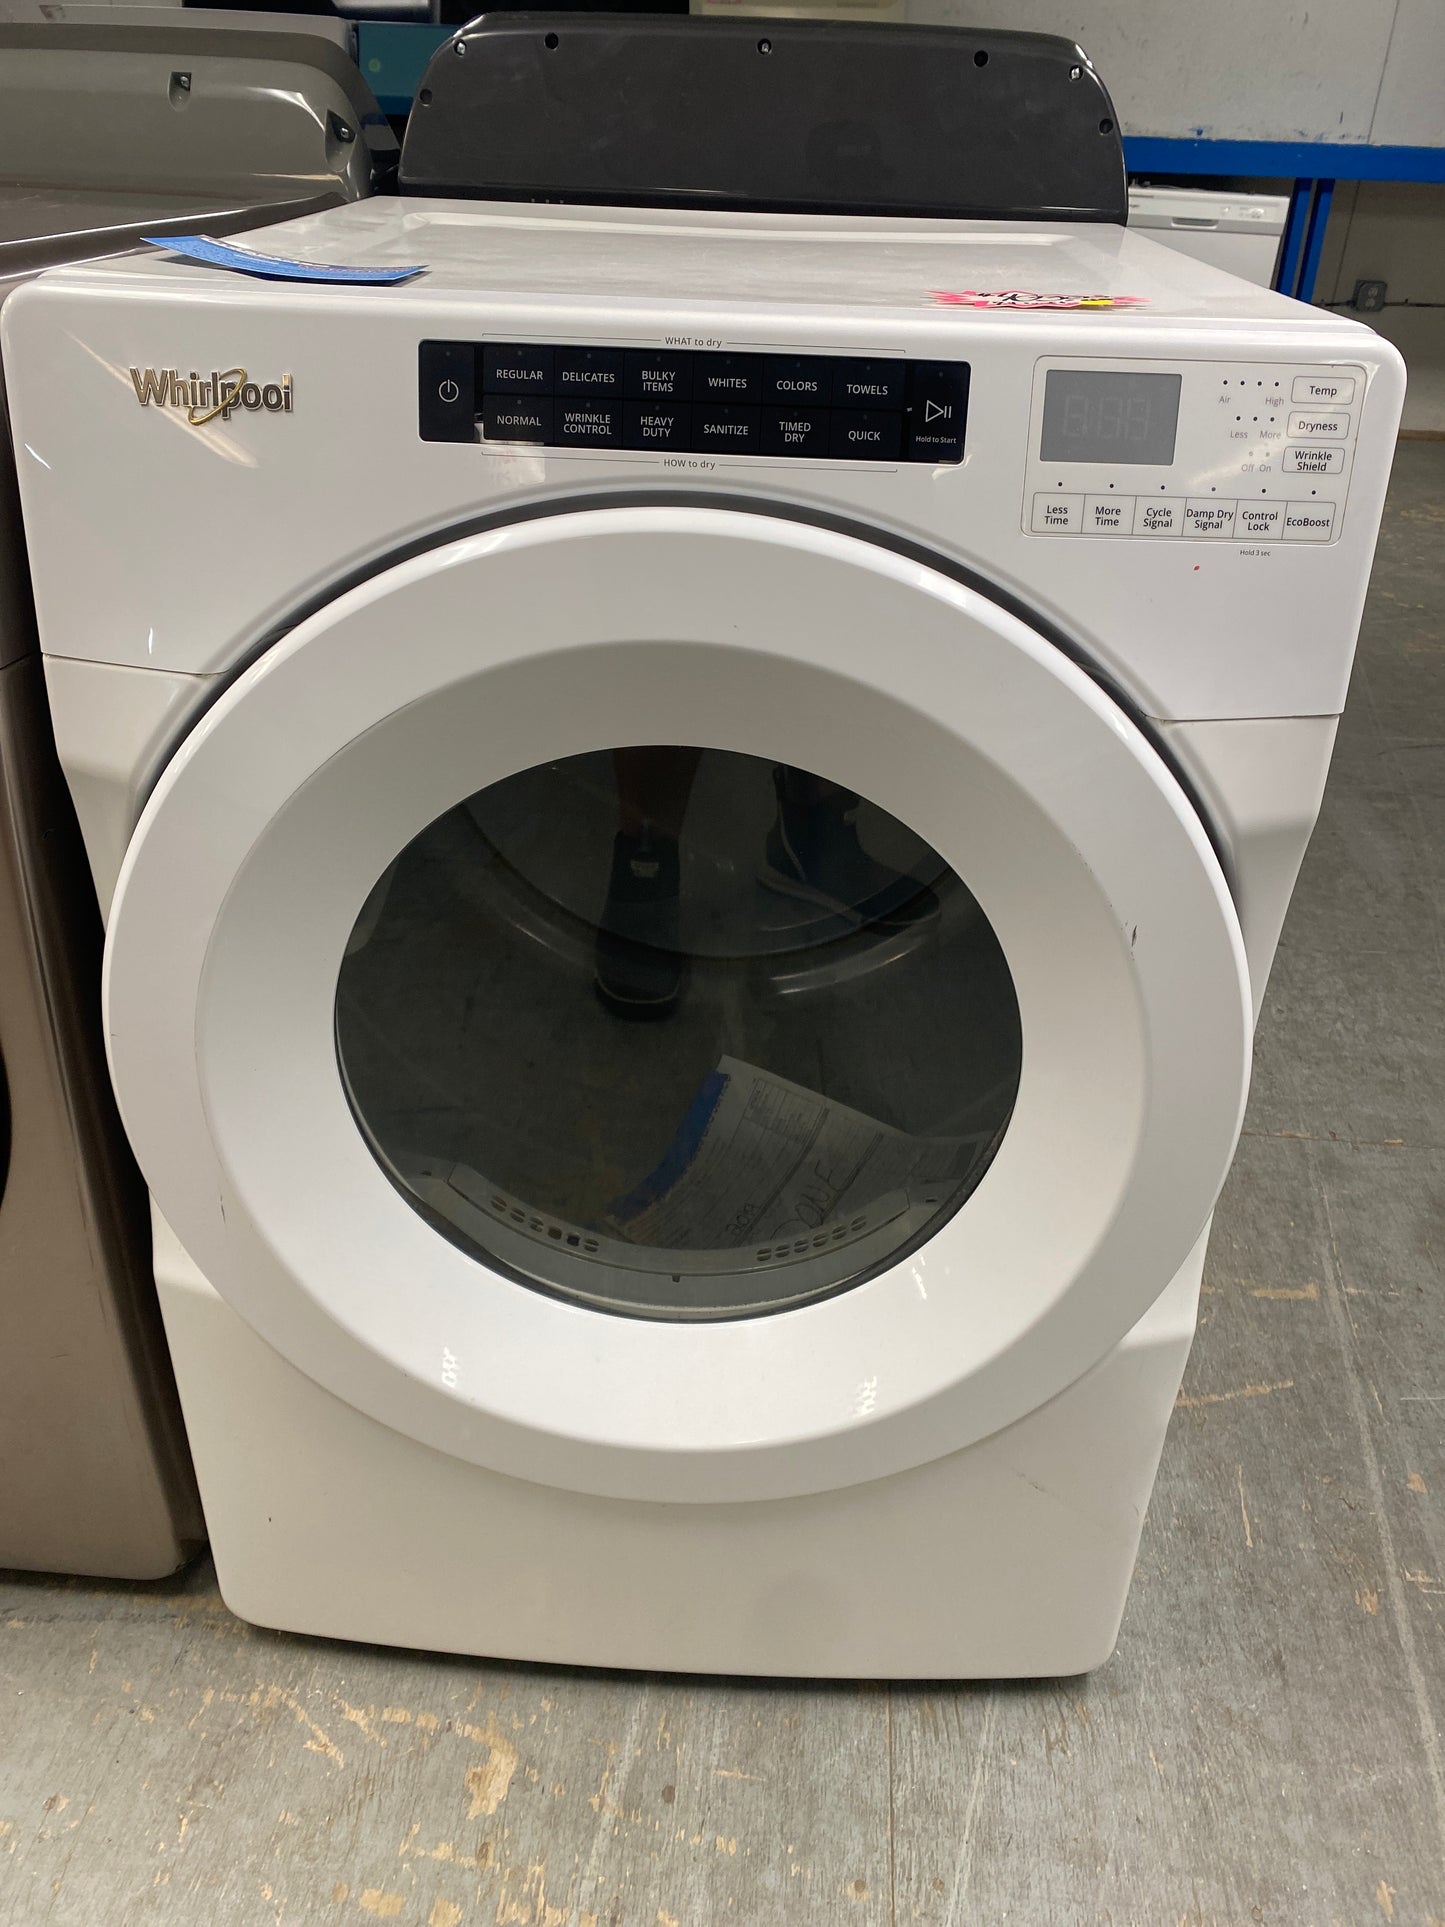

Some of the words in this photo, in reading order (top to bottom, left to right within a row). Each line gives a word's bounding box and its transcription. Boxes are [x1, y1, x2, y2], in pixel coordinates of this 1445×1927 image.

[665, 337, 692, 346] WHAT
[694, 338, 704, 346] to
[706, 338, 722, 348] dry
[496, 368, 543, 380] REGULAR
[562, 371, 615, 383] DELICATES
[641, 370, 676, 382] BULKY
[642, 381, 674, 392] ITEMS
[708, 377, 748, 389] WHITES
[776, 380, 818, 392] COLORS
[129, 367, 293, 424] Whirlpool
[846, 384, 889, 396] TOWELS
[1309, 385, 1338, 398] Temp
[1219, 395, 1231, 404] Air
[1265, 395, 1285, 407] High
[496, 415, 542, 426] NORMAL
[564, 412, 611, 424] WRINKLE
[640, 415, 674, 427] HEAVY
[563, 423, 612, 435] CONTROL
[642, 426, 671, 438] DUTY
[703, 424, 749, 436] SANITIZE
[778, 421, 811, 433] TIMED
[1298, 420, 1338, 433] Dryness
[784, 432, 805, 443] DRY
[848, 430, 881, 442] QUICK
[915, 435, 931, 443] Hold
[932, 436, 939, 444] to
[940, 436, 957, 444] Start
[1230, 430, 1249, 440] Less
[1259, 430, 1282, 440] More
[1294, 450, 1333, 462] Wrinkle
[663, 459, 686, 468] HOW
[688, 459, 698, 468] to
[700, 460, 716, 470] dry
[1241, 463, 1255, 473] Off
[1259, 464, 1272, 473] On
[1296, 461, 1327, 472] Shield
[1046, 504, 1068, 515] Less
[1095, 505, 1121, 517] More
[1145, 506, 1172, 520] Cycle
[1186, 508, 1216, 520] Damp
[1217, 509, 1234, 522] Dry
[1241, 510, 1278, 521] Control
[1044, 515, 1069, 526] Time
[1095, 516, 1120, 527] Time
[1143, 516, 1173, 530] Signal
[1194, 519, 1223, 531] Signal
[1247, 520, 1270, 532] Lock
[1286, 516, 1330, 528] EcoBoost
[1239, 549, 1254, 557] Hold
